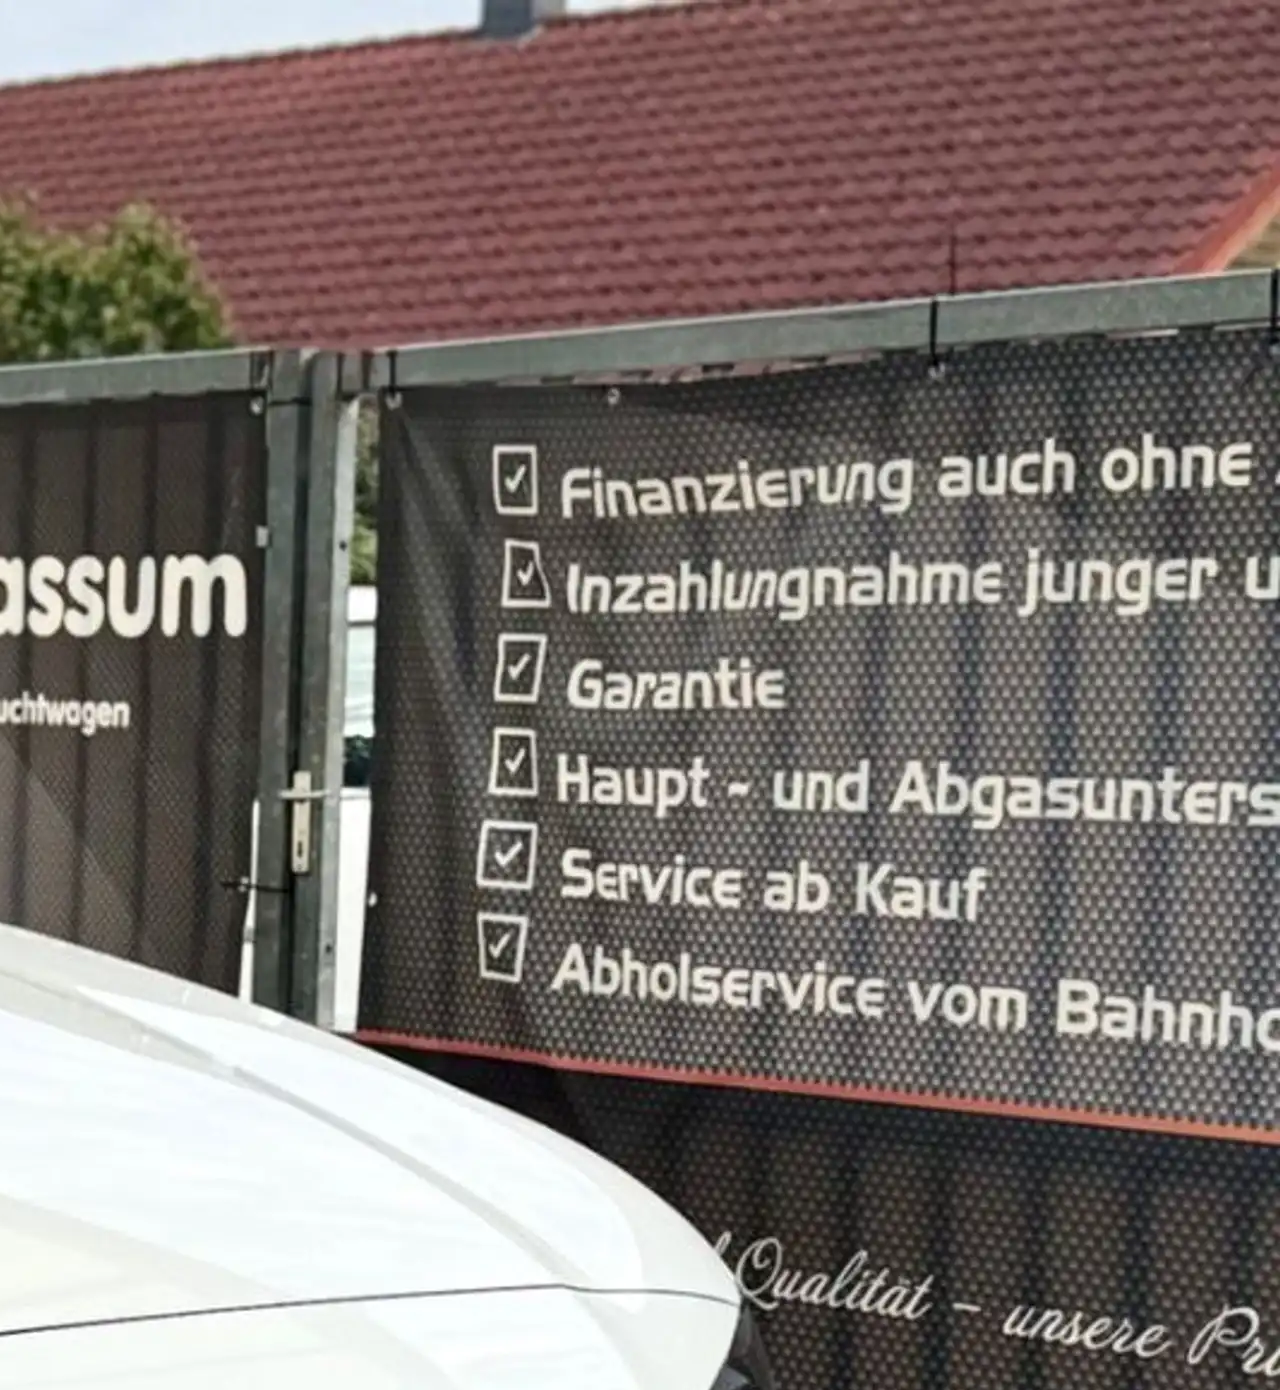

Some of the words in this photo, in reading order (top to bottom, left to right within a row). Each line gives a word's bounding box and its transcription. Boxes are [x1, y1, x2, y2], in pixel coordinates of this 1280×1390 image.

[561, 458, 914, 519] Finanzierung
[938, 437, 1077, 498] auch
[1101, 432, 1253, 492] ohne
[566, 550, 1003, 621] Inzahlungnahme
[1017, 546, 1220, 618] junger
[567, 657, 787, 710] Garantie
[556, 753, 711, 819] Haupt
[773, 758, 871, 814] und
[889, 760, 1280, 831] Abgasunters
[560, 848, 743, 909] Service
[763, 858, 832, 913] ab
[854, 861, 989, 922] Kauf
[550, 942, 890, 1018] Abholservice
[907, 980, 1029, 1034] vom
[1055, 977, 1280, 1051] Bahnho
[735, 1235, 934, 1321] Qualität
[1002, 1304, 1175, 1358] unsere
